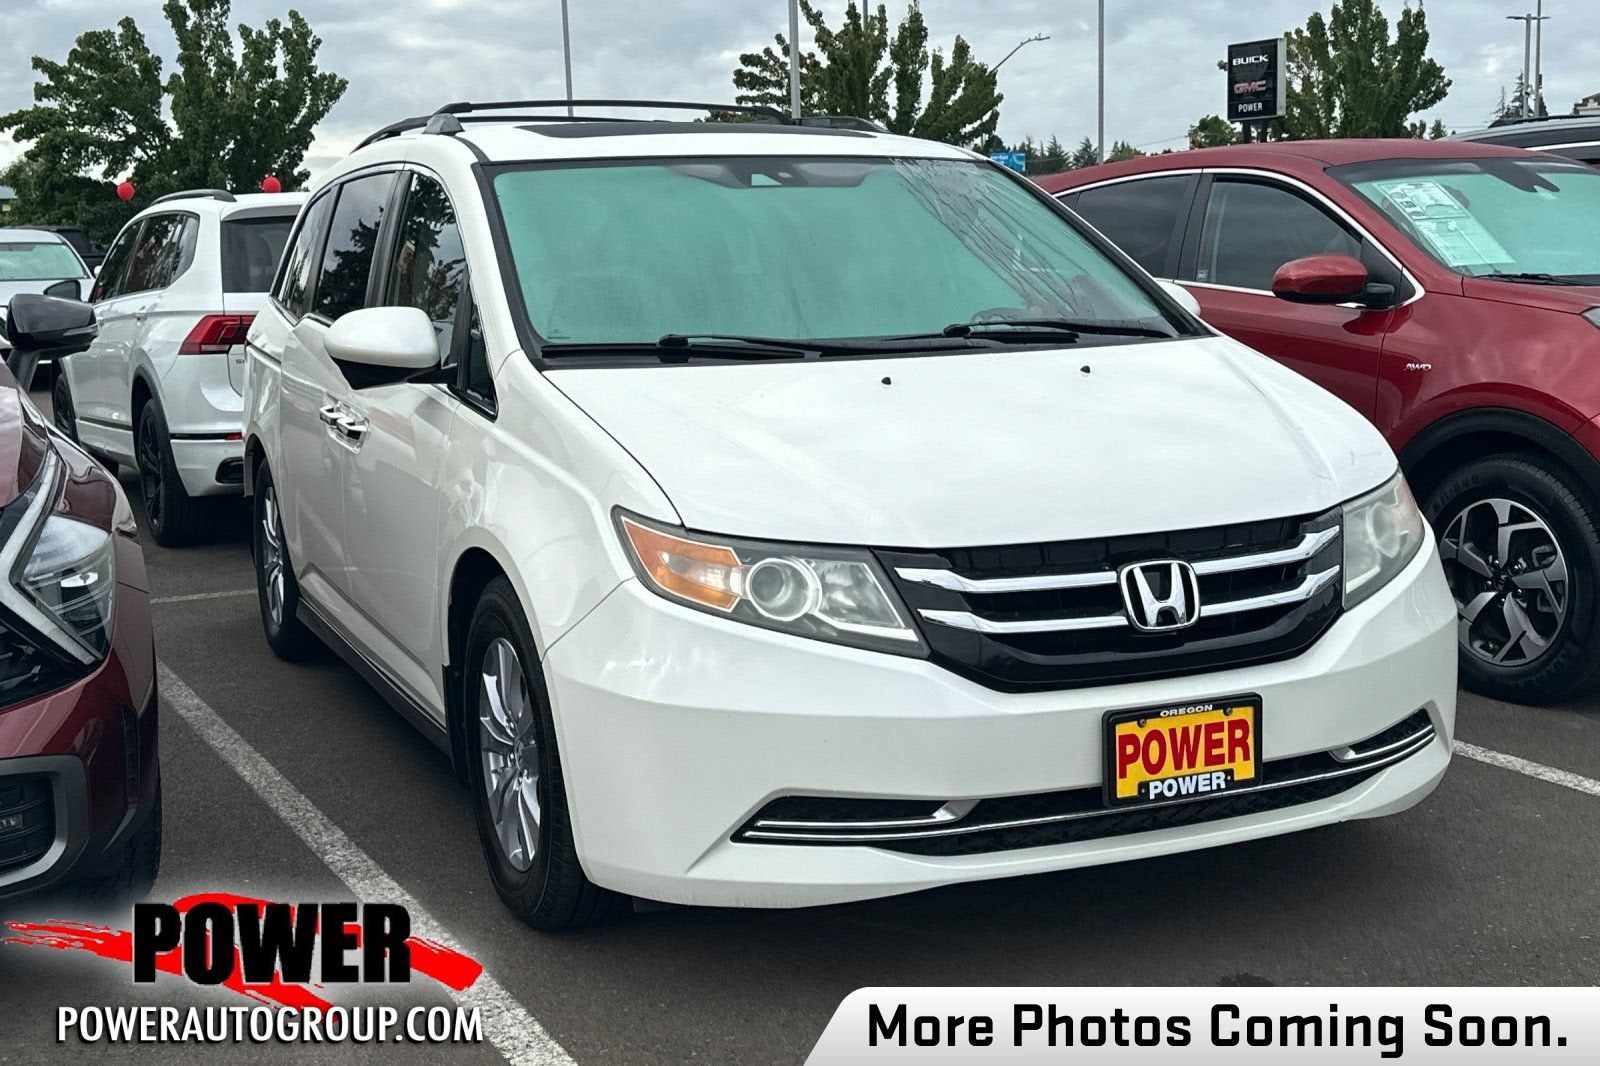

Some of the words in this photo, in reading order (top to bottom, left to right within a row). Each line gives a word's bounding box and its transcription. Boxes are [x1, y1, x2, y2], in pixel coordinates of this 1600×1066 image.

[1232, 54, 1268, 66] BUICK
[1234, 80, 1266, 94] GMC
[1238, 102, 1263, 113] POWER
[1404, 363, 1432, 371] AWD
[1159, 704, 1213, 718] OREGON
[1118, 718, 1251, 779] POWER
[1148, 771, 1227, 800] POWER
